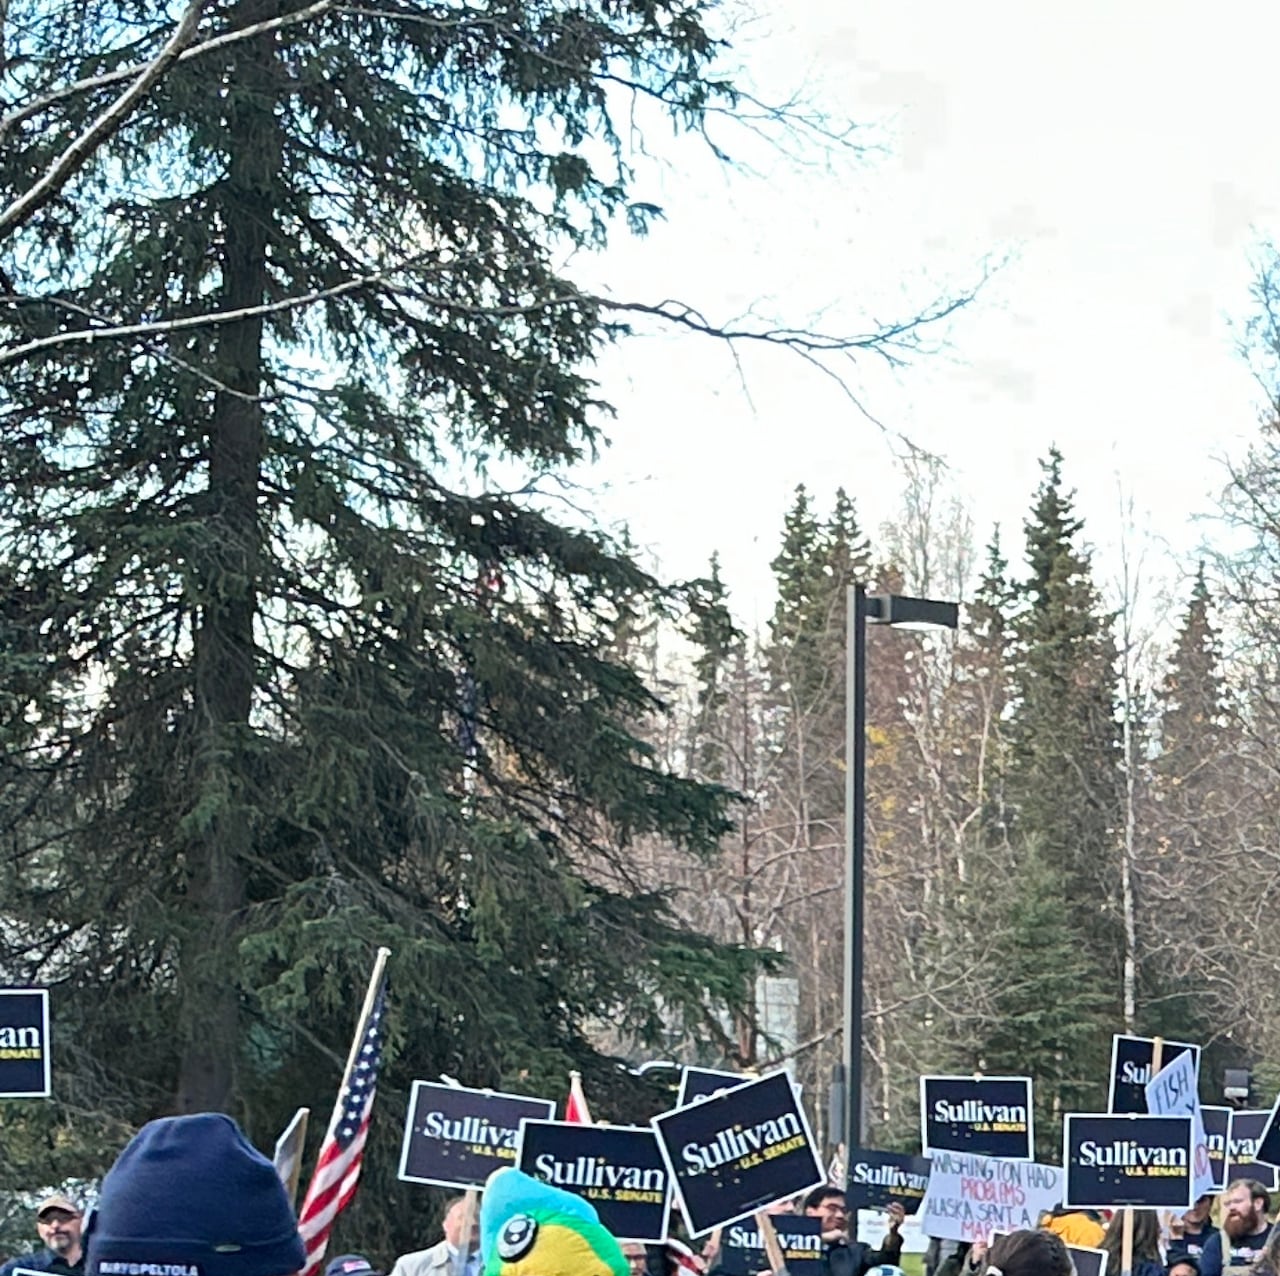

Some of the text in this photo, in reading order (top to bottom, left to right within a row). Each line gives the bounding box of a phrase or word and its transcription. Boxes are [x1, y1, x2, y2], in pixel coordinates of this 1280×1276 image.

[0, 1048, 41, 1059] ENATE
[1155, 1064, 1189, 1113] FISH
[935, 1100, 1026, 1123] Sullivan
[423, 1112, 519, 1149] Sulliva
[682, 1112, 801, 1176] Sullivan
[740, 1136, 806, 1169] U.S. SENATE
[1079, 1141, 1187, 1167] Sullivan
[534, 1154, 664, 1190] Sullivan
[853, 1163, 929, 1190] Sullivan
[931, 1153, 1056, 1189] WASHINGTON HAD
[588, 1188, 662, 1203] U.S. SENATE
[927, 1198, 971, 1218] ALASKA
[1021, 1208, 1031, 1225] A
[728, 1227, 821, 1251] Sulvan
